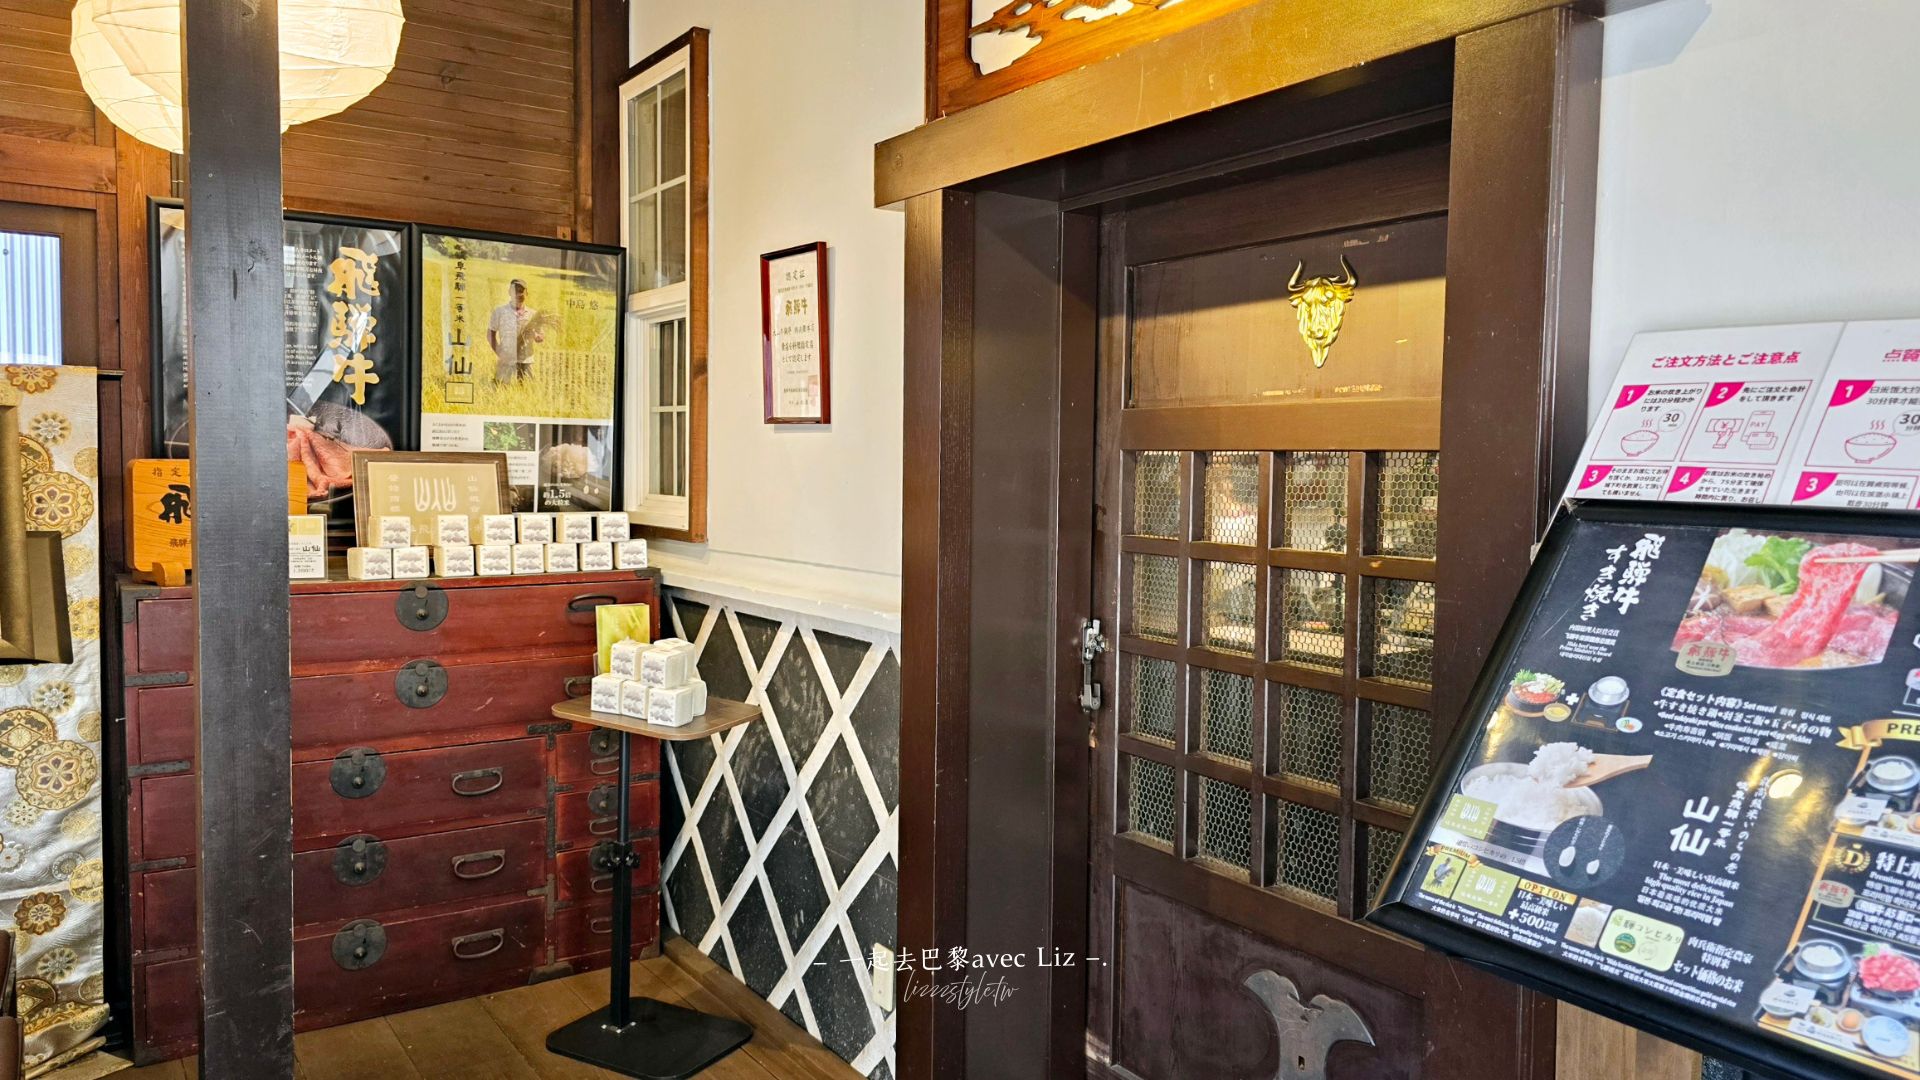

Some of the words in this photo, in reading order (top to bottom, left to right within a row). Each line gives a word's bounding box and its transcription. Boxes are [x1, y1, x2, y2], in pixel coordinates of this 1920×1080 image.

[1651, 351, 1801, 368] ご注文方法とご注意点
[1627, 389, 1634, 401] 1
[1716, 387, 1729, 399] 2
[1845, 385, 1854, 398] 1
[1663, 413, 1680, 422] 30
[1899, 414, 1920, 424] 30
[152, 466, 190, 478] 指定
[1588, 470, 1598, 482] 3
[1680, 472, 1691, 485] 4
[1806, 477, 1819, 492] 3
[1612, 533, 1666, 615] 飛騨牛
[1580, 544, 1628, 621] すき焼き
[1670, 796, 1720, 857] 山仙
[1524, 882, 1567, 900] OPTION
